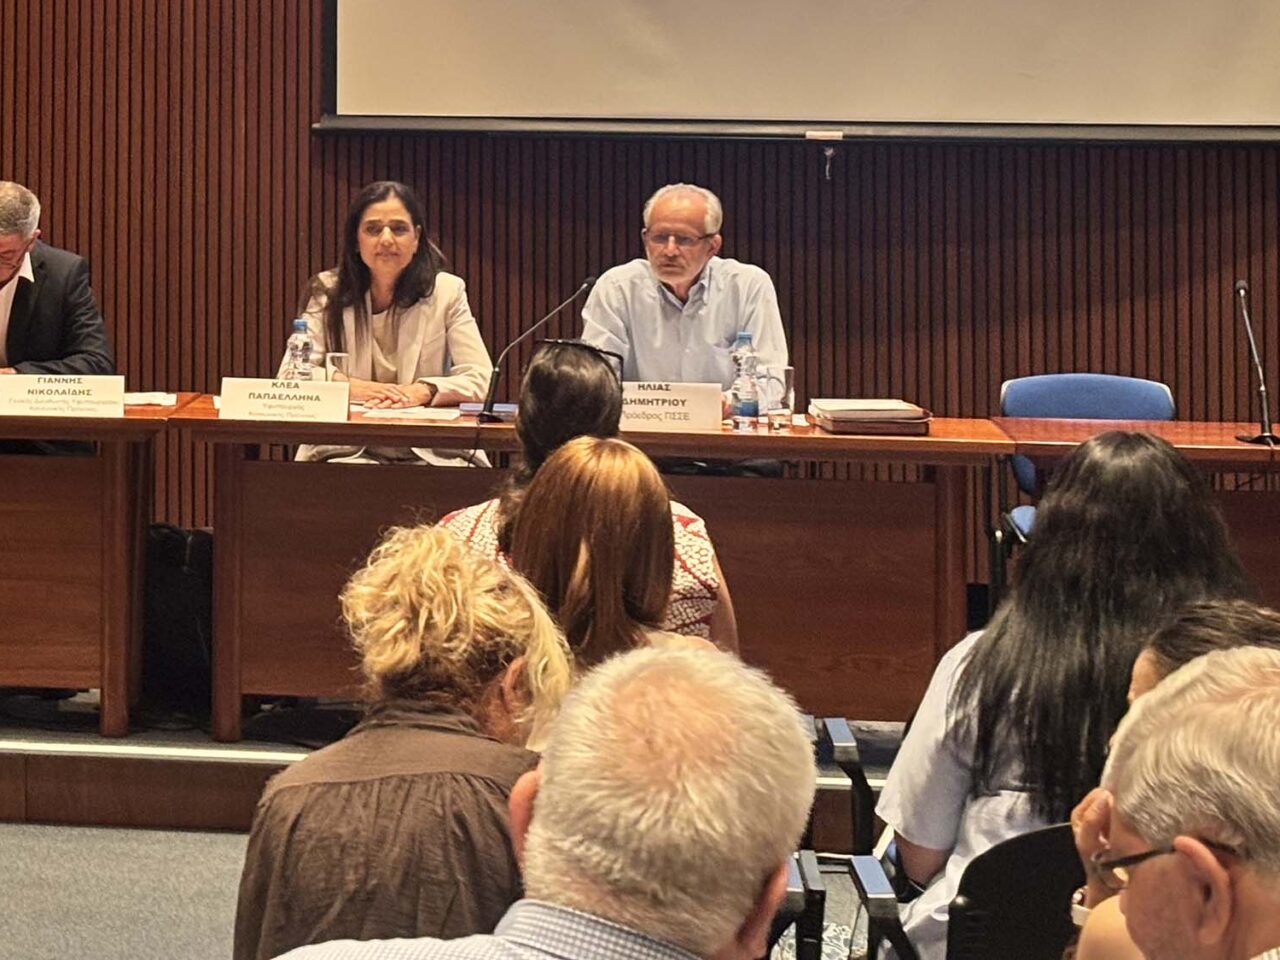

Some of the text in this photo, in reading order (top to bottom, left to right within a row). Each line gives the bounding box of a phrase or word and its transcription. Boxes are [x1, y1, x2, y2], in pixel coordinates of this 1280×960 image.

[271, 381, 300, 389] ΚΛΕΑ
[637, 383, 672, 391] ΗΛΙΑΣ
[248, 392, 321, 401] ΠΑΠΑΕΛΛΗΝΑ
[622, 398, 687, 407] ΔΗΜΗΤΡΙΟΥ
[623, 410, 662, 421] ρόεδρος
